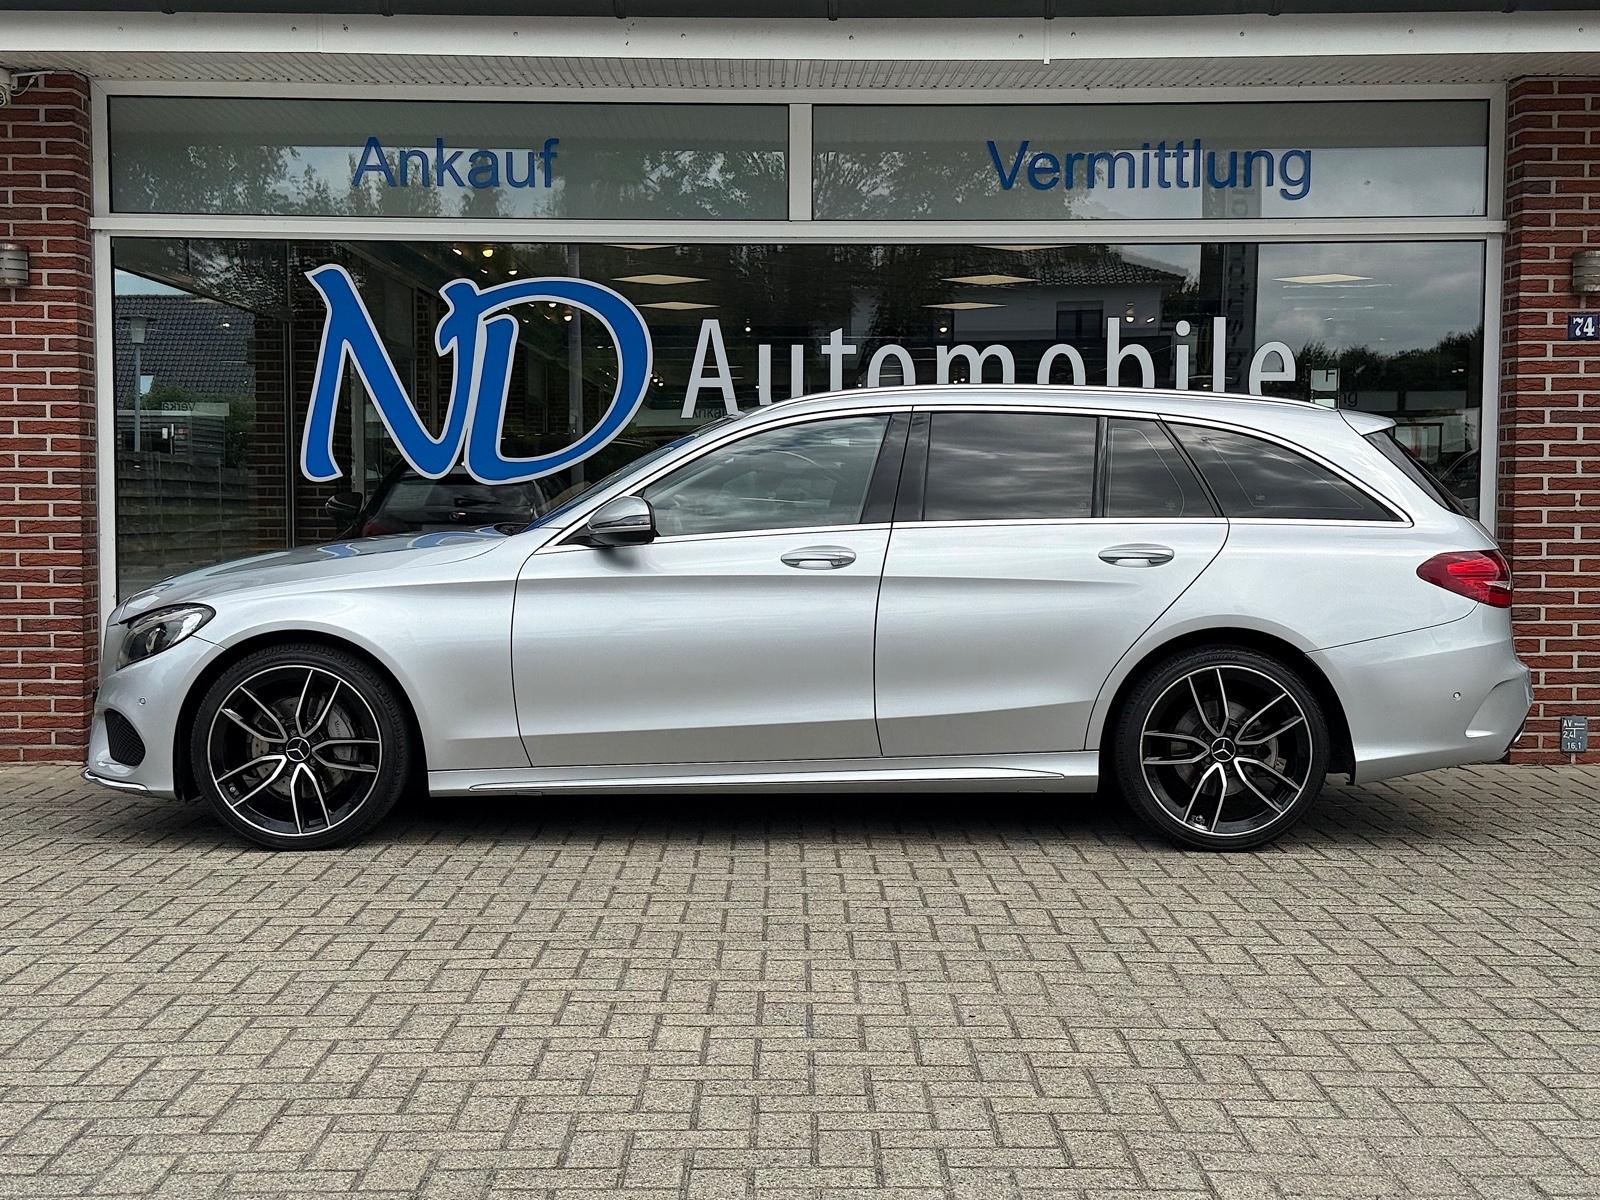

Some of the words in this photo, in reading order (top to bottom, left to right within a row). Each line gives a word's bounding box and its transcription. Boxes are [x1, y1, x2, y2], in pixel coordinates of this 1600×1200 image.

[353, 137, 558, 189] Ankauf
[987, 140, 1312, 200] Vermittlung
[1572, 317, 1595, 337] 74
[301, 264, 652, 485] ND
[681, 317, 1297, 419] Automobile
